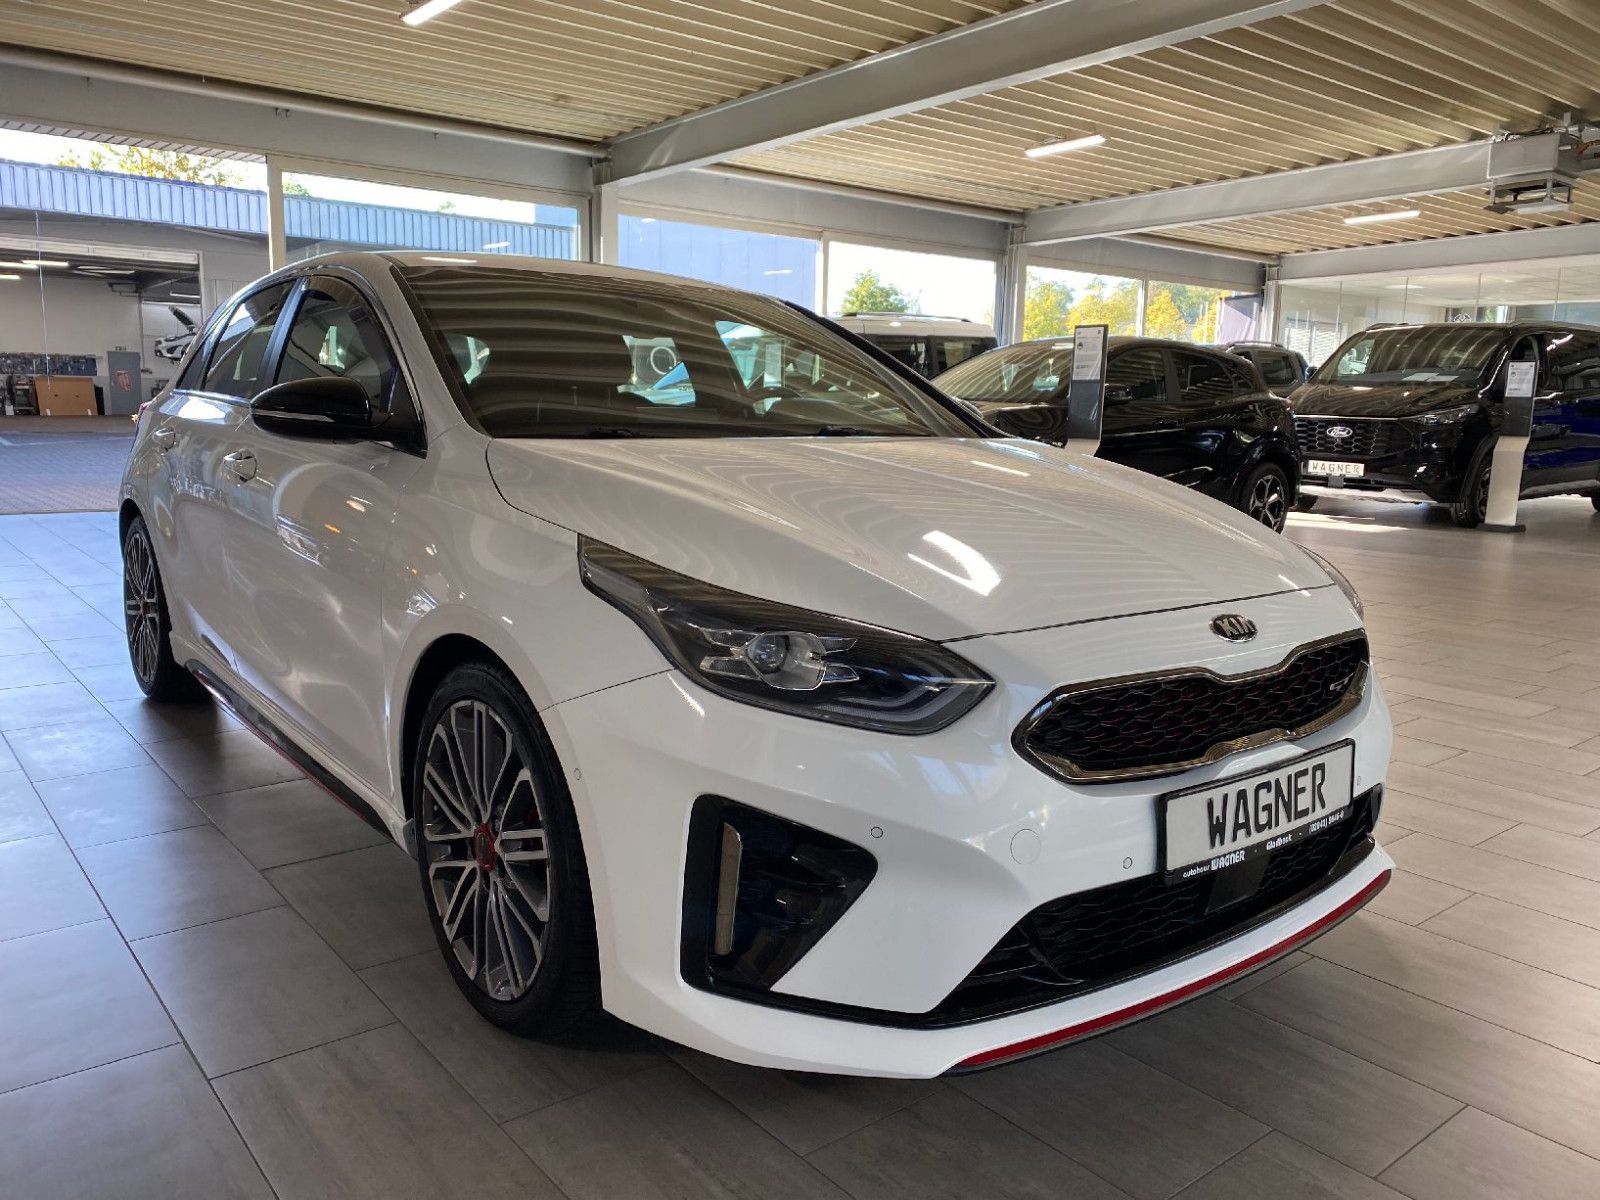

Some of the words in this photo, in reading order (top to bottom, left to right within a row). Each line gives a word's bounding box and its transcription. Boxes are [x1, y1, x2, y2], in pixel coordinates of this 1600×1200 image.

[1312, 462, 1361, 474] WAGNER
[1215, 617, 1255, 637] KIA
[1207, 762, 1326, 850] WAGNER
[1211, 850, 1246, 871] WAGNER
